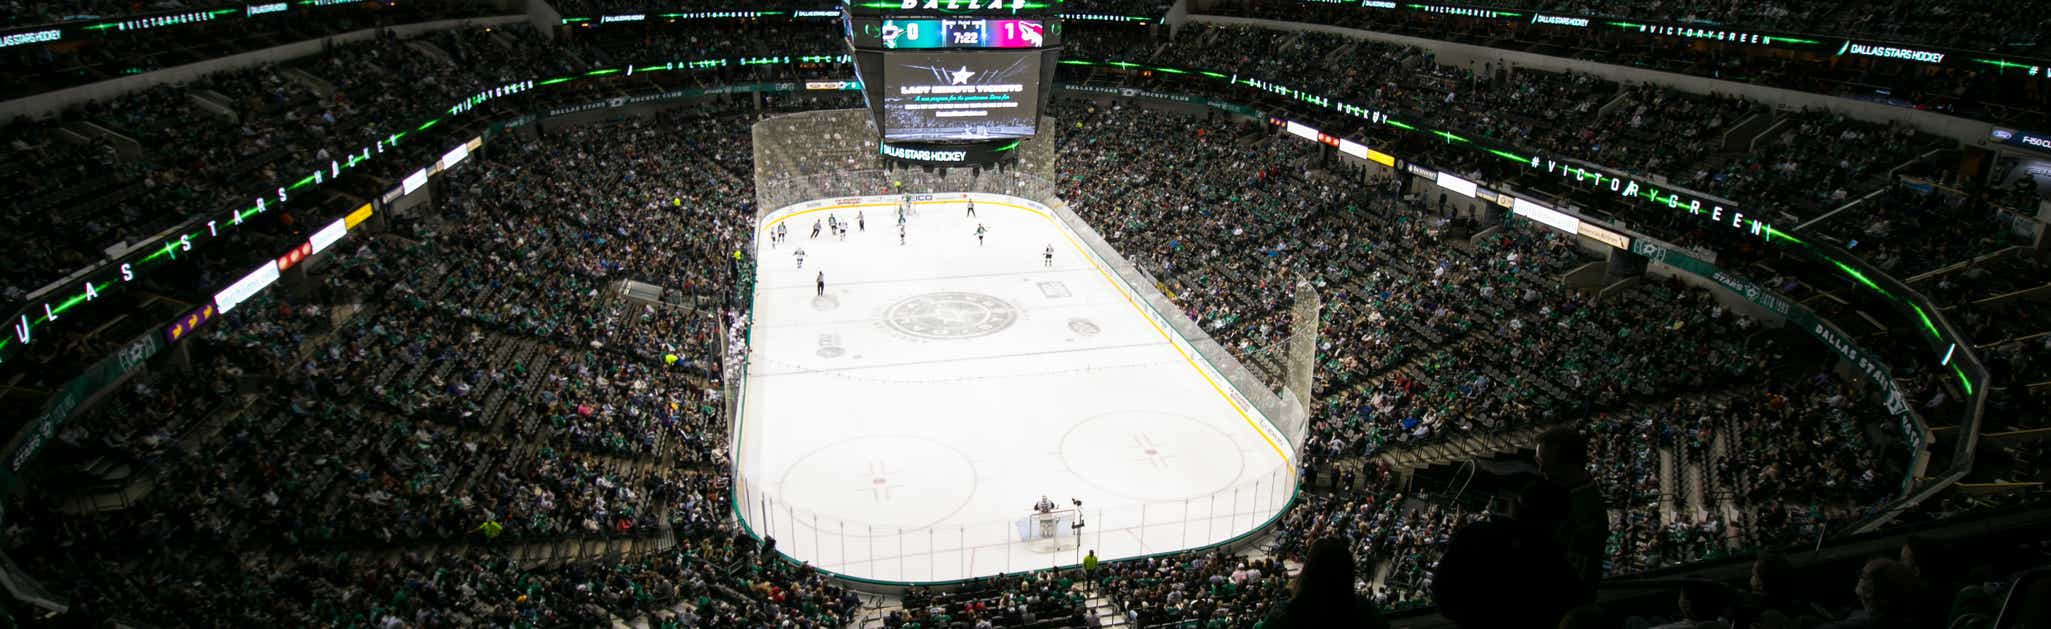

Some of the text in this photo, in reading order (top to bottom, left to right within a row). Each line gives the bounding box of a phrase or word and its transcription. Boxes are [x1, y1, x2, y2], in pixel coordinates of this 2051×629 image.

[907, 23, 918, 40] 0
[953, 32, 978, 44] 7:22
[1005, 23, 1014, 40] 1
[1850, 44, 1944, 63] DALLAS STARS HOCKEY
[883, 144, 966, 161] DALLAS STARS HOCKEY
[1531, 156, 1762, 236] #VICTORYGREEN
[180, 187, 287, 252] STARS
[1815, 324, 1857, 360] DALLAS
